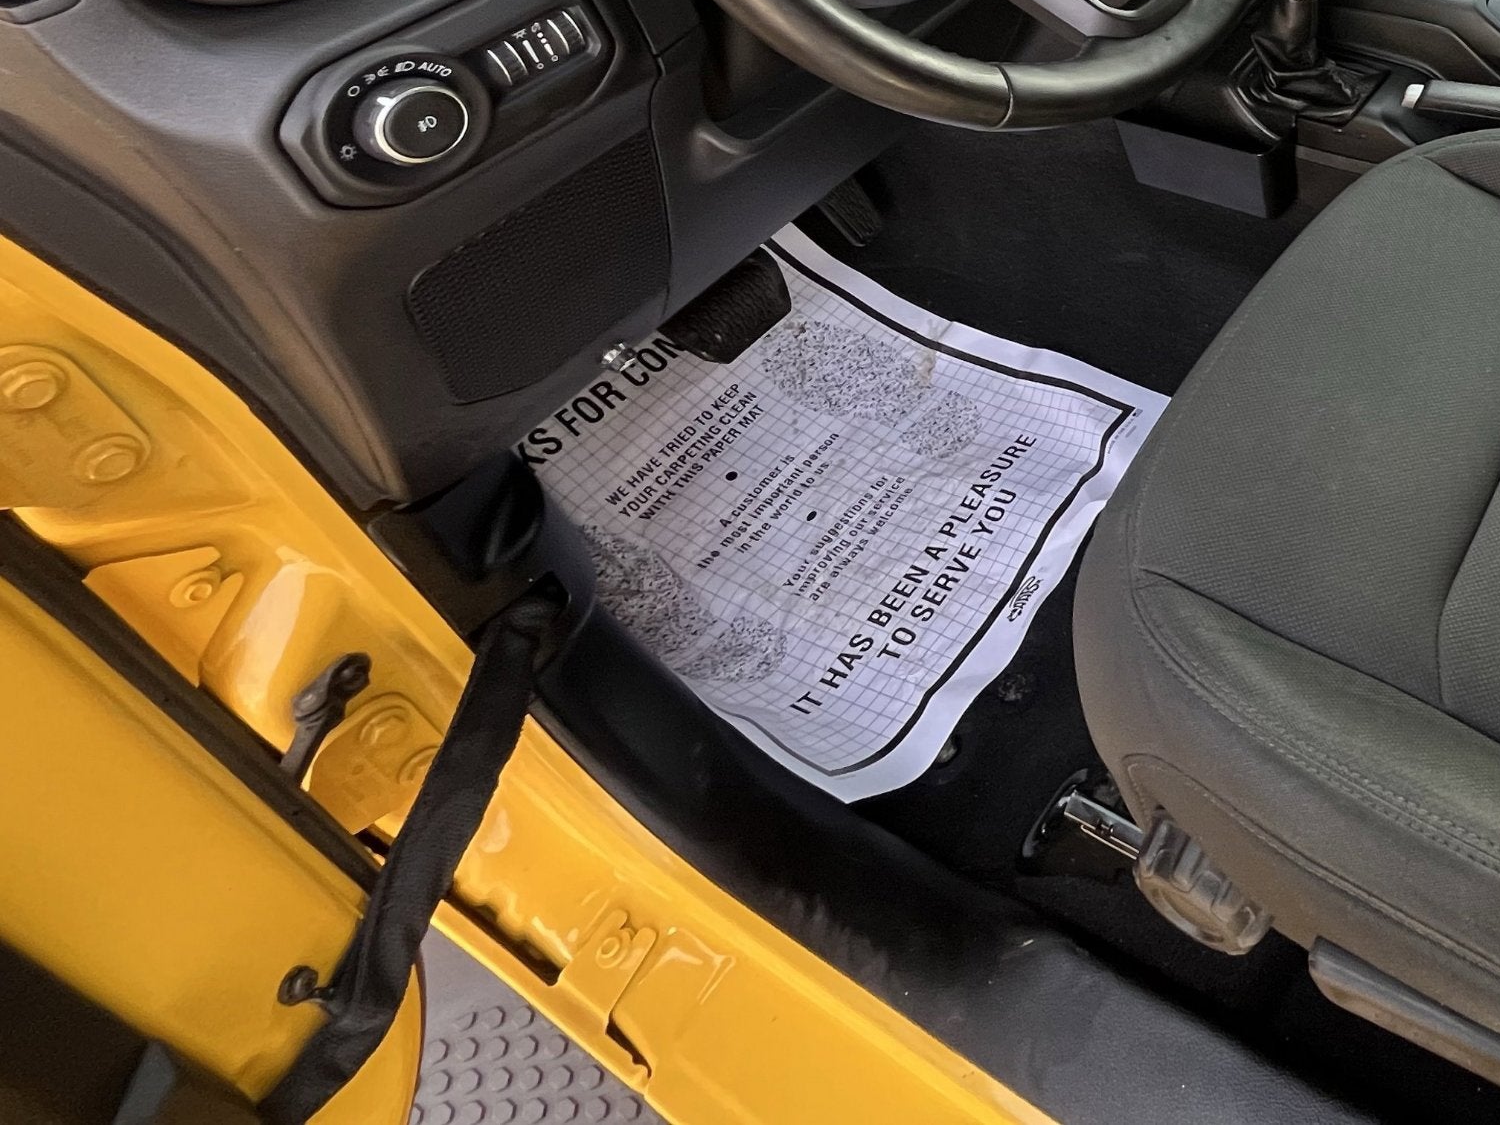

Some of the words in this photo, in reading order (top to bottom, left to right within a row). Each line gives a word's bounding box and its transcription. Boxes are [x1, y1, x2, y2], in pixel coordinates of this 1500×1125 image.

[417, 60, 453, 78] AUTO
[554, 381, 627, 437] FOR
[605, 485, 630, 506] WE
[626, 457, 663, 488] HAVE
[659, 425, 697, 457] TRIED
[694, 410, 714, 426] TO
[711, 383, 740, 411] KEEP
[619, 485, 659, 518] YOUR
[655, 425, 722, 486] CARPETING
[718, 391, 758, 425] CLEAN
[639, 489, 676, 520] WITH
[673, 462, 704, 489] THIS
[701, 427, 742, 463] PAPER
[738, 404, 765, 429] MAT
[697, 550, 720, 569] the
[719, 520, 753, 548] most
[750, 467, 805, 520] important
[802, 432, 840, 468] person
[719, 517, 732, 528] A
[731, 465, 783, 519] customer
[780, 454, 795, 466] is
[736, 541, 752, 554] in
[748, 522, 772, 544] the
[770, 488, 803, 522] world
[800, 476, 815, 489] to
[782, 559, 811, 588] Your
[810, 492, 875, 556] suggestions
[870, 475, 889, 492] for
[793, 539, 853, 597] improving
[849, 517, 869, 538] our
[867, 476, 907, 518] service
[789, 691, 823, 715] IT
[818, 633, 874, 690] HAS
[866, 564, 931, 628] BEEN
[924, 543, 949, 561] A
[938, 434, 1038, 539] PLEASURE
[809, 581, 832, 602] are
[831, 537, 870, 578] always
[876, 627, 917, 660] TO
[910, 542, 982, 623] SERVE
[970, 487, 1018, 535] YOU
